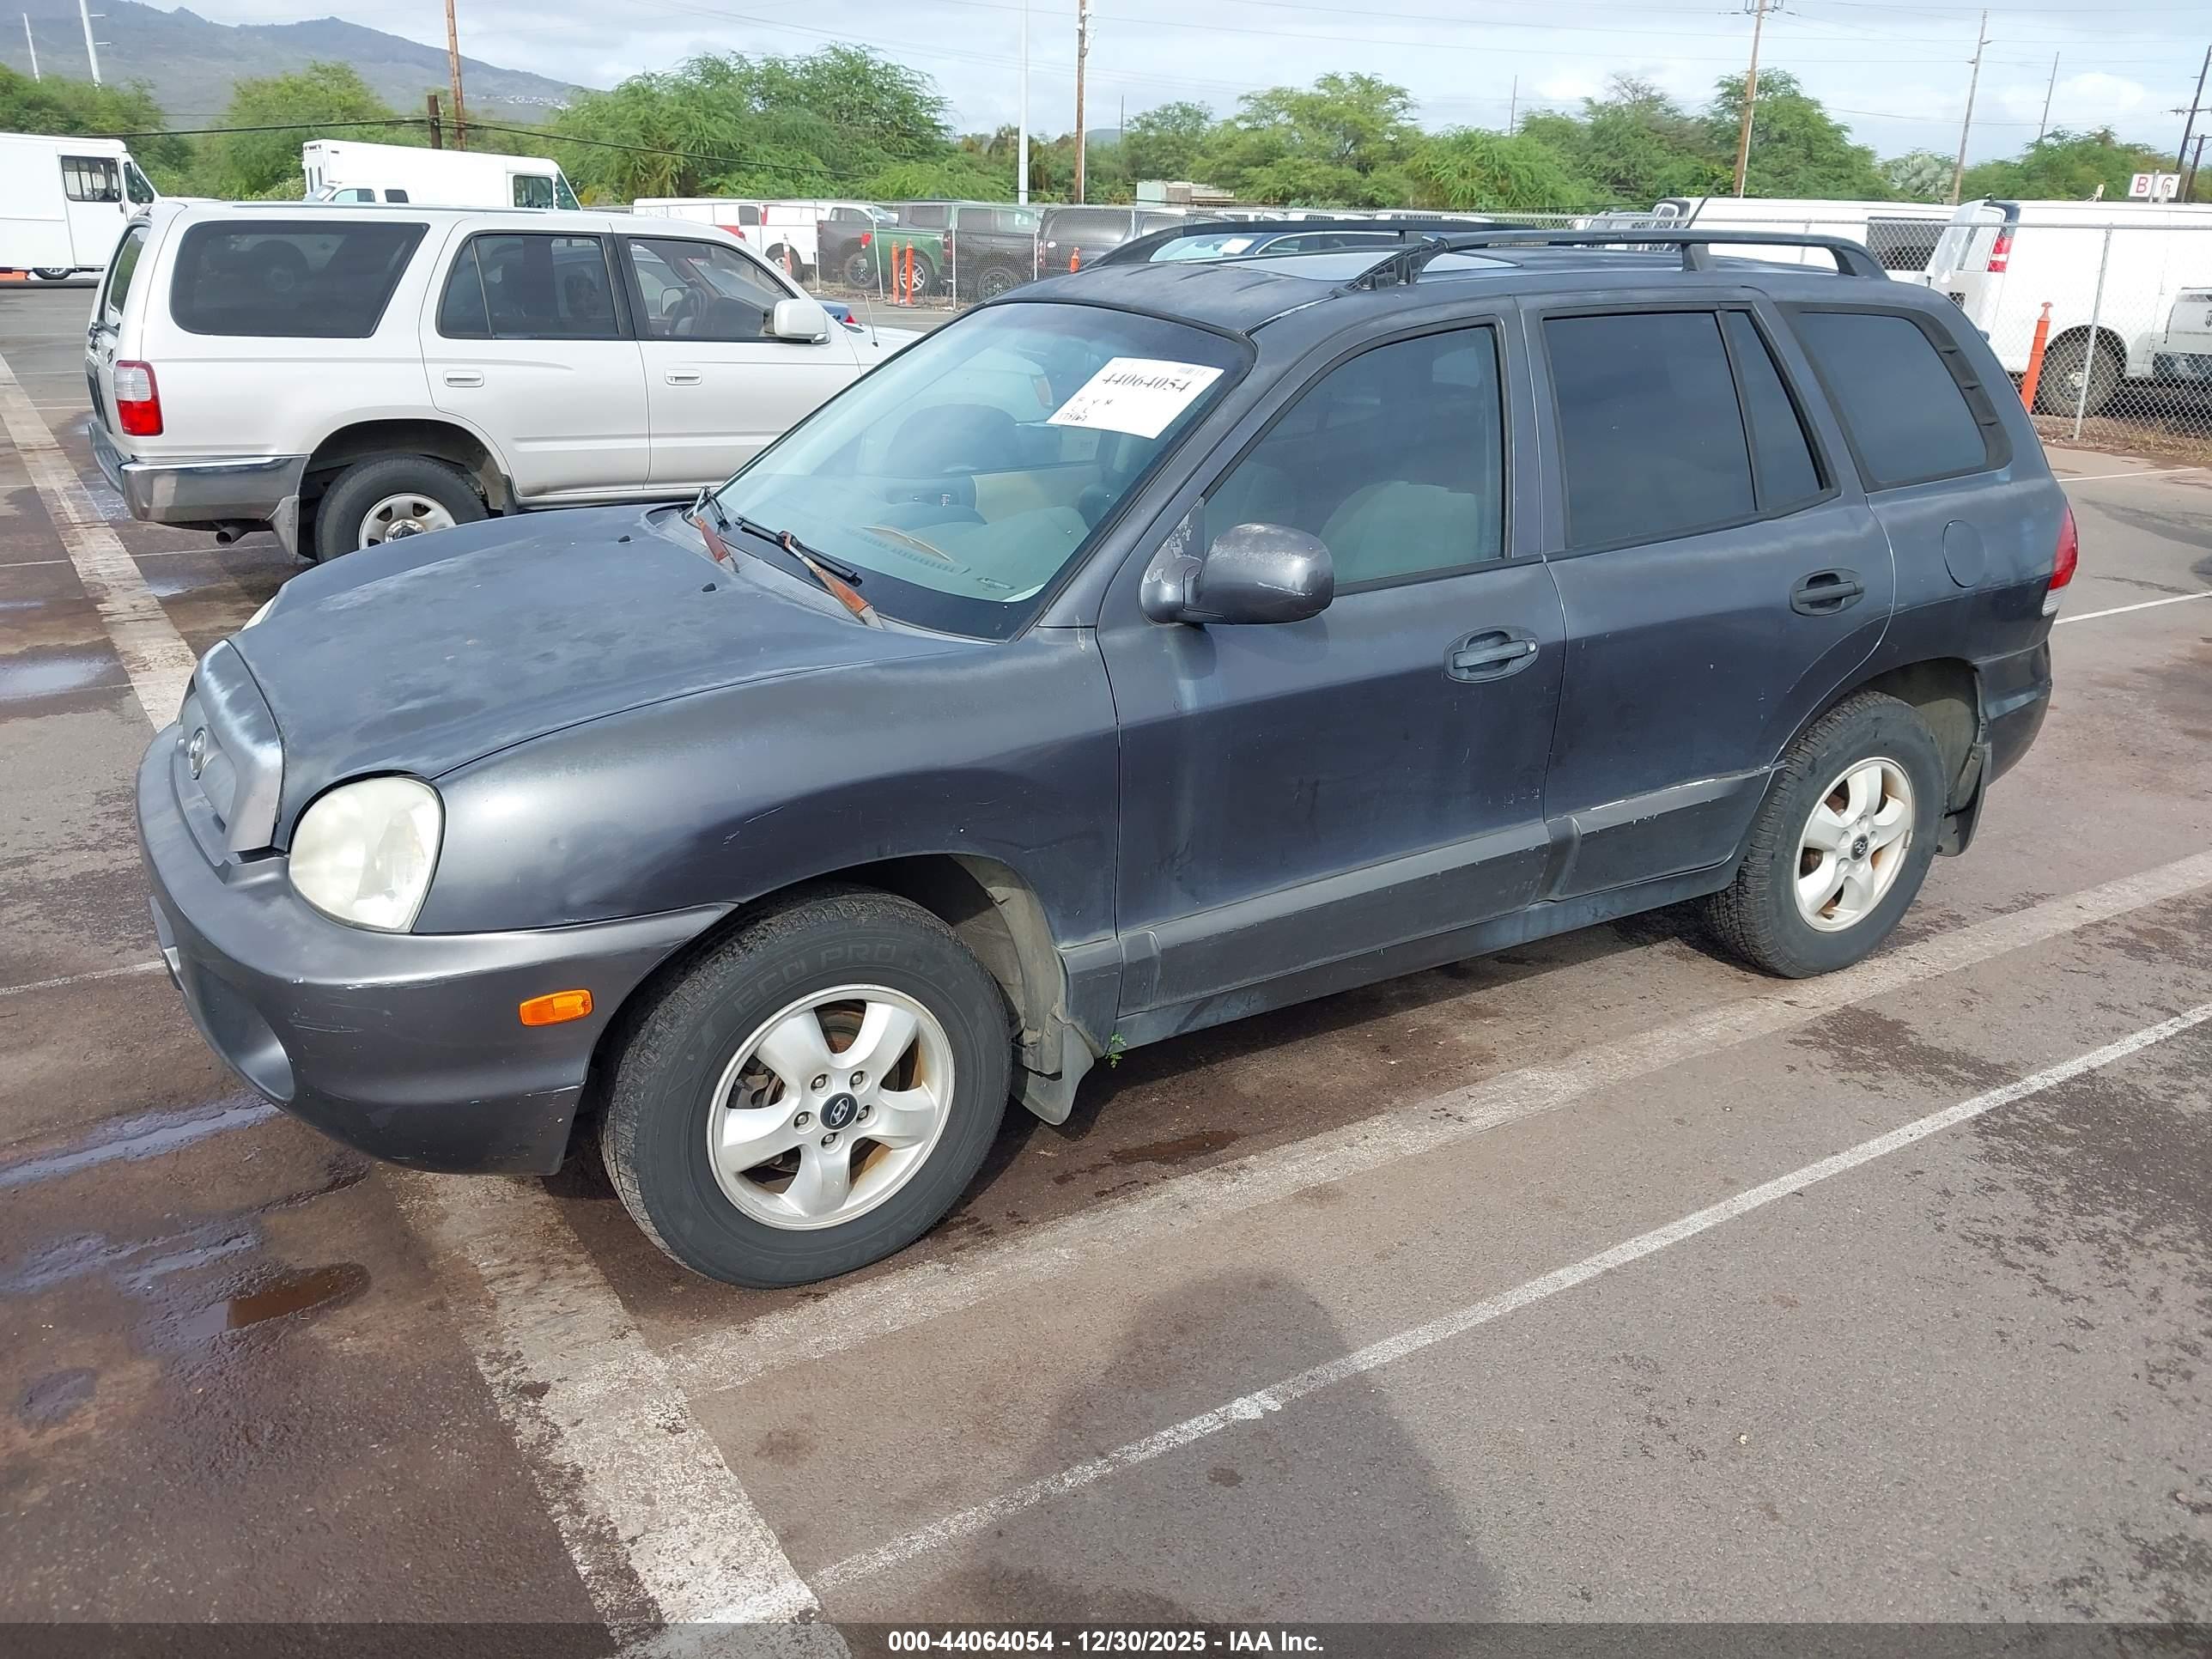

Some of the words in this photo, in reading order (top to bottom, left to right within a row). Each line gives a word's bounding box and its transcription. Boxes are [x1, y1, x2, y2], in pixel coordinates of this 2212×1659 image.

[2136, 176, 2148, 193] B
[1102, 373, 1192, 392] 44064054
[819, 944, 896, 969] PRO
